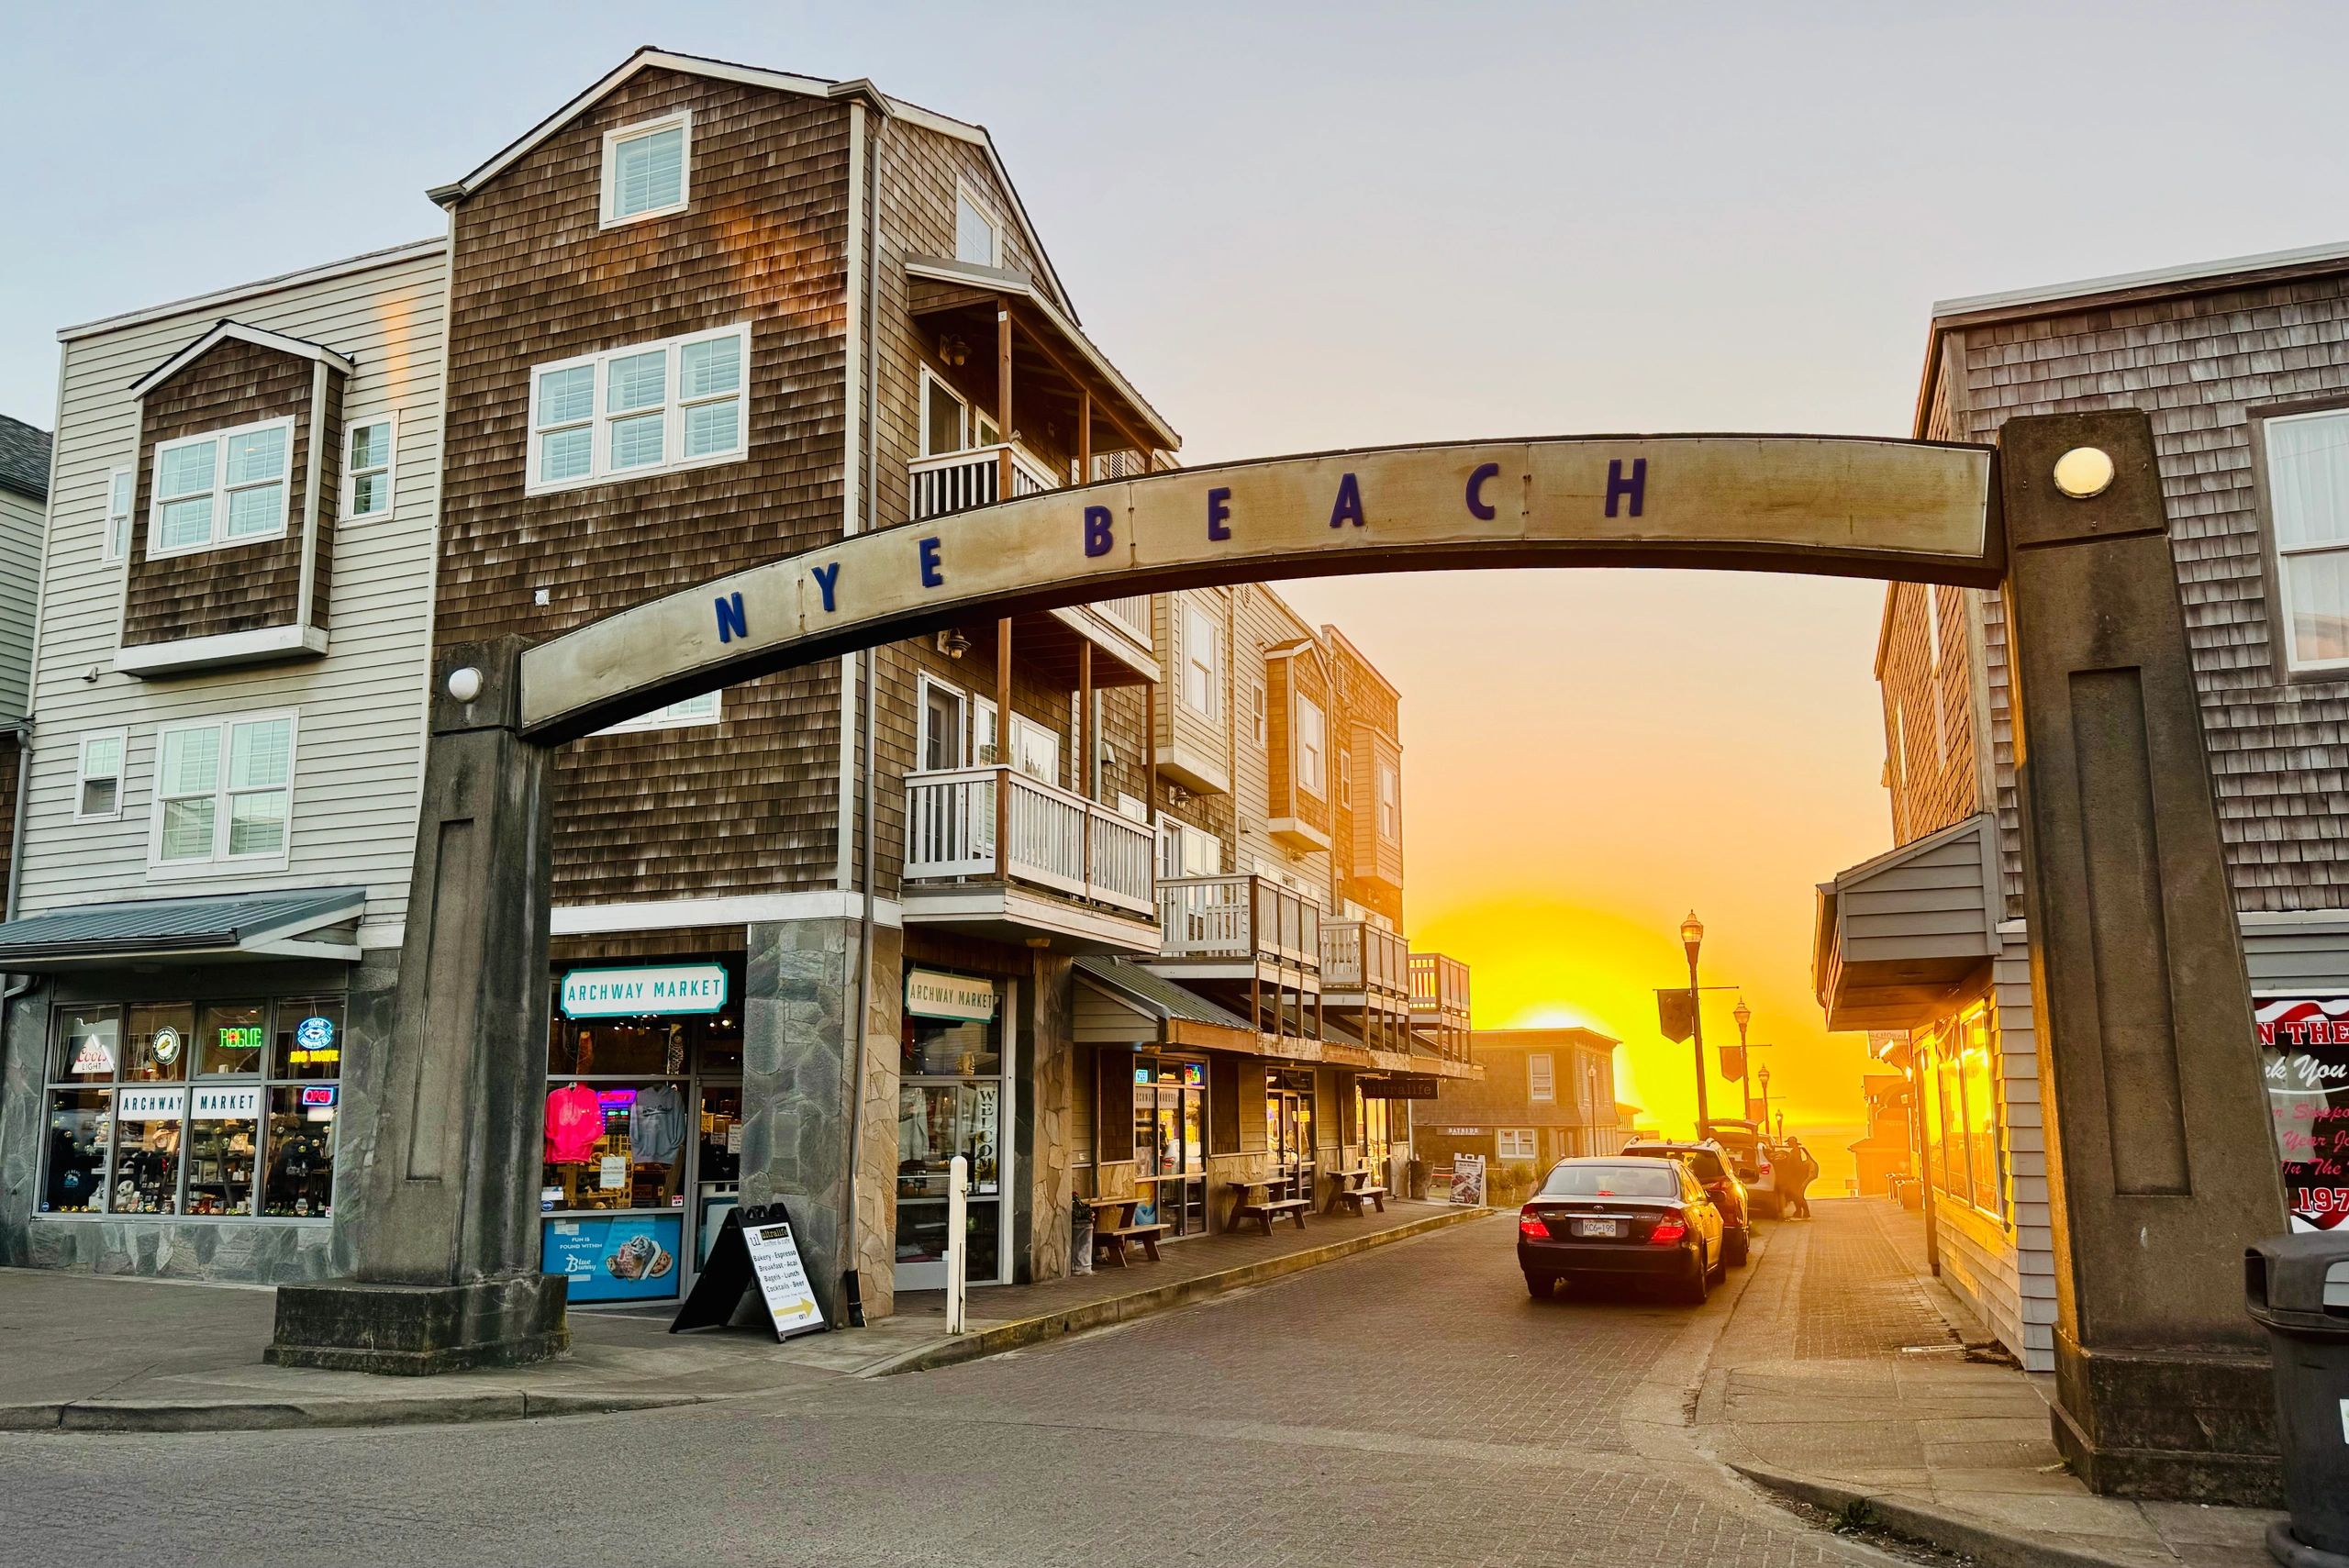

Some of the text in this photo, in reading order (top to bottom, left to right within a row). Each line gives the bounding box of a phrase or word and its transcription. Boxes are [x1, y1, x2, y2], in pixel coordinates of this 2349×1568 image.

[715, 458, 1647, 643] NYE BEACH
[568, 979, 720, 1001] ARCHWAY MARKET
[910, 984, 992, 1008] ARCHWAY MARKET
[219, 1028, 262, 1047] ROGUE
[2256, 1022, 2276, 1045] N
[2294, 1054, 2347, 1087] You
[306, 1090, 331, 1102] OPEN
[1367, 1084, 1431, 1095] ultralife
[124, 1095, 254, 1110] ARCHWAY MARKET
[2293, 1102, 2349, 1123] Suppo
[979, 1090, 996, 1172] WELCOM
[2307, 1158, 2342, 1175] The
[2298, 1187, 2349, 1212] 197
[761, 1228, 787, 1239] ultralife
[752, 1253, 772, 1262] Bakery
[774, 1250, 796, 1260] Espresso
[758, 1262, 784, 1272] Breakfast
[763, 1273, 781, 1283] Bagels
[785, 1270, 800, 1279] Lunch
[765, 1283, 790, 1293] Cocktails
[793, 1280, 805, 1288] Beer
